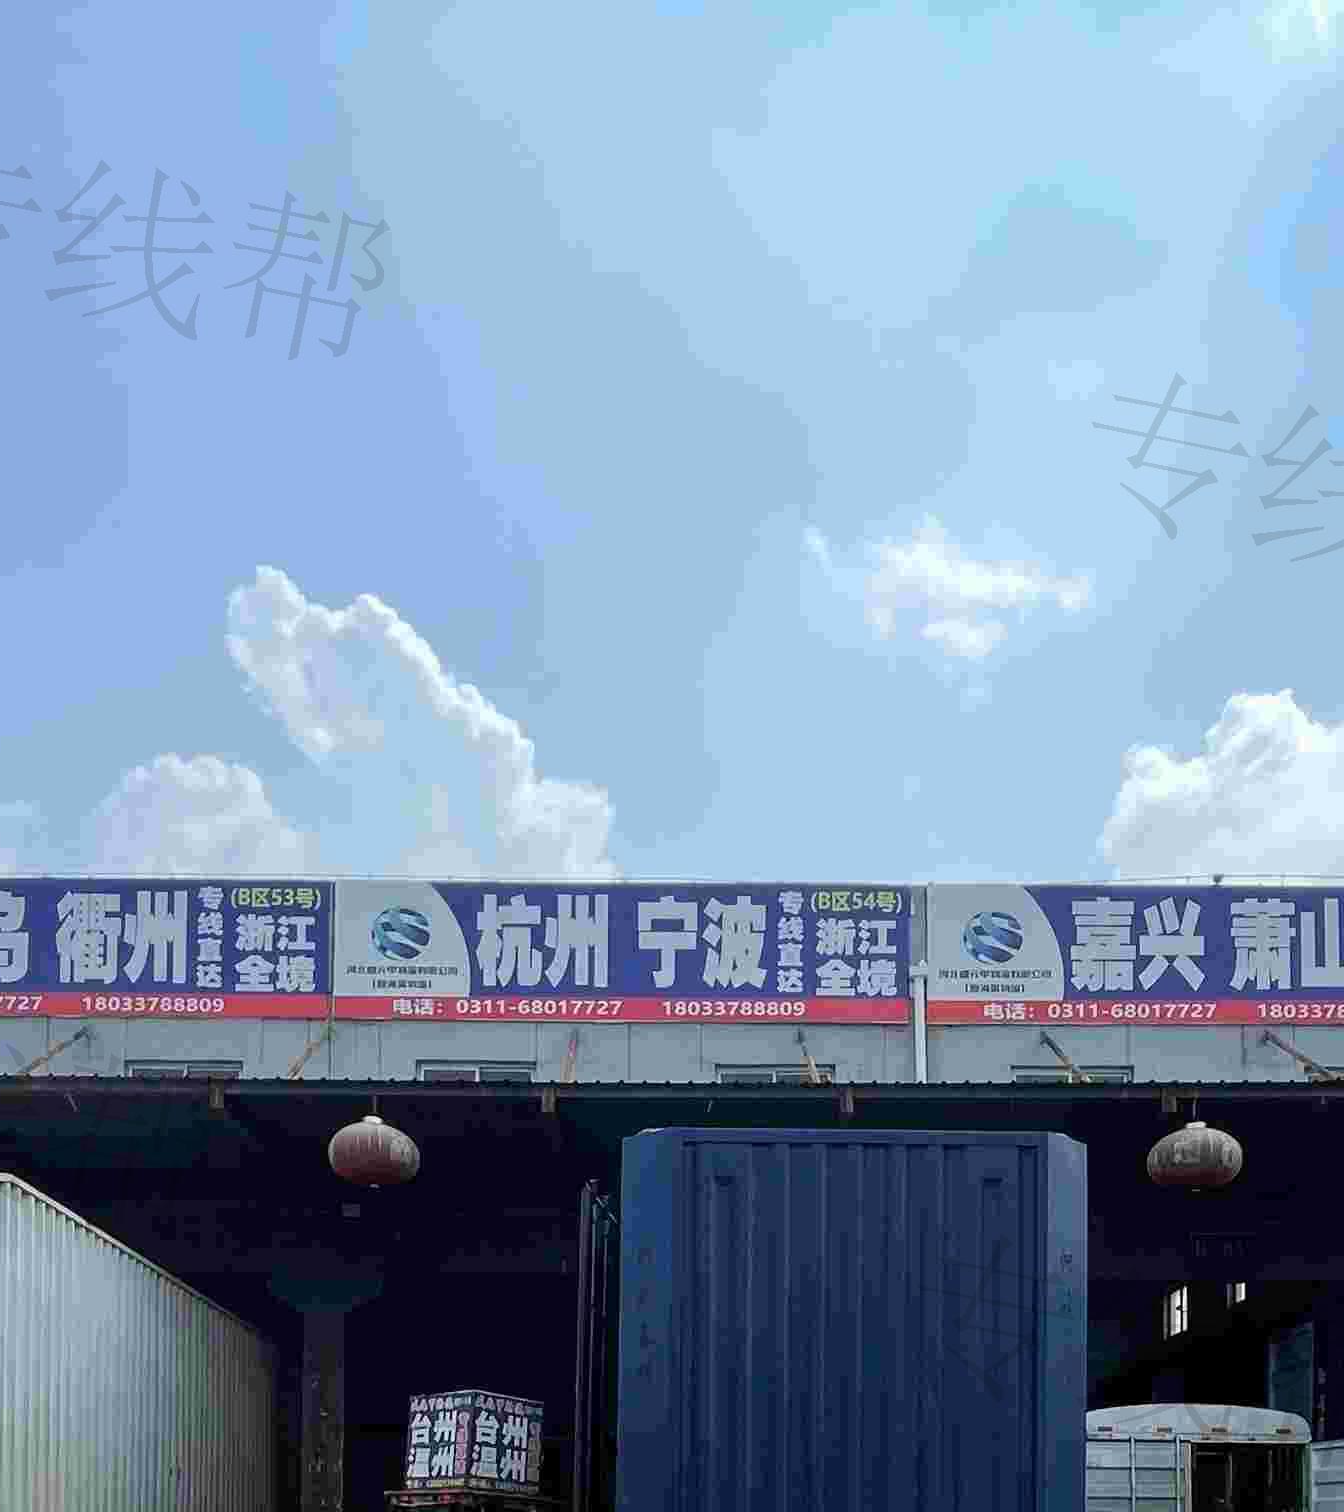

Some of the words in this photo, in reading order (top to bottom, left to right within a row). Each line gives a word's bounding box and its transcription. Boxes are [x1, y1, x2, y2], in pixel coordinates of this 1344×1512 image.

[56, 890, 188, 984] 衢州
[235, 914, 316, 951] 浙江
[476, 894, 609, 987] 杭州
[637, 896, 767, 989] 宁波
[815, 918, 897, 955] 浙江
[1070, 897, 1205, 992] 嘉兴
[235, 954, 316, 992] 全境
[815, 959, 897, 996] 全境
[82, 996, 224, 1012] 18033788809
[456, 1000, 623, 1015] 0311-68017727
[662, 1001, 805, 1017] 18033788809
[1048, 1004, 1217, 1019] 0311-68017727
[411, 1411, 457, 1446] 台州
[475, 1410, 528, 1449] 台州
